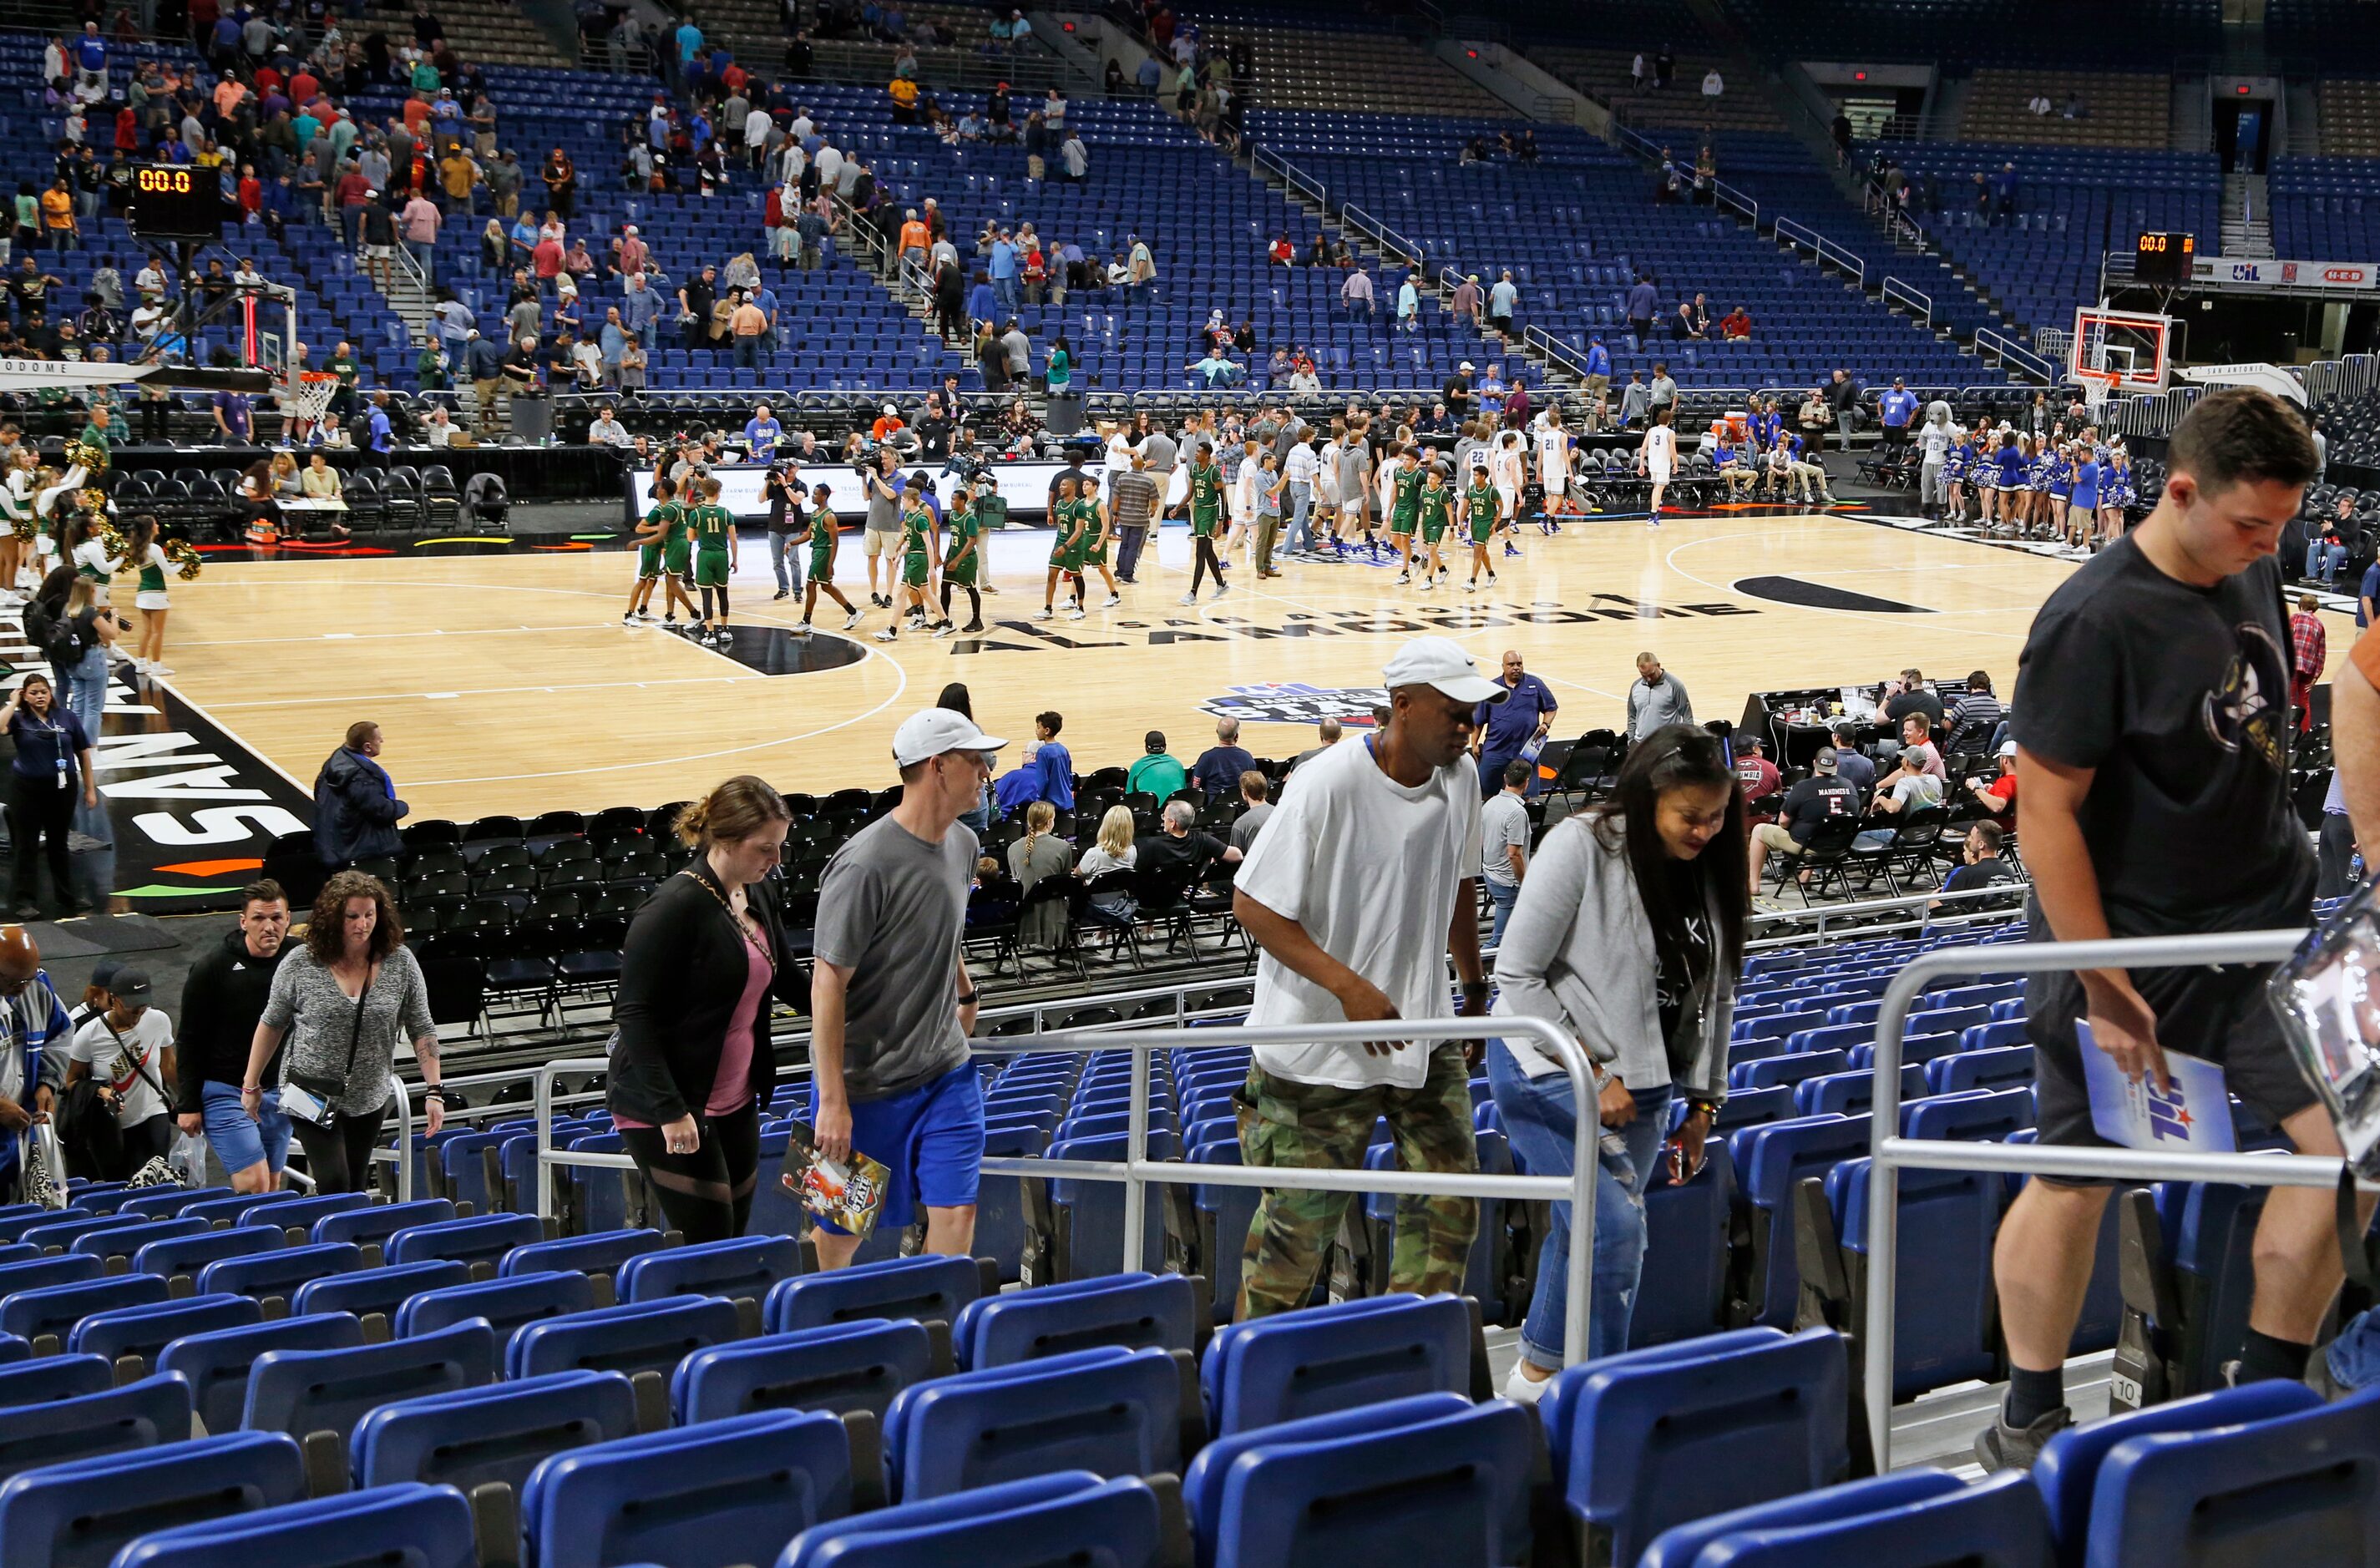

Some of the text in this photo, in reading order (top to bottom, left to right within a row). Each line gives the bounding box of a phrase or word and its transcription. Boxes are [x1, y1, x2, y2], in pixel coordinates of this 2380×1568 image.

[139, 169, 190, 192] 00.0
[2140, 235, 2165, 251] 00.0
[1546, 439, 1553, 450] 21
[1655, 435, 1660, 445] 3
[1472, 451, 1483, 463] 22
[1384, 469, 1389, 479] 4
[1398, 478, 1409, 488] COLE
[1196, 488, 1204, 498] 15
[1400, 488, 1405, 497] 0
[1423, 497, 1435, 506] COLE
[1426, 506, 1431, 515] 3
[1474, 505, 1483, 515] 12
[706, 517, 720, 533] 11
[950, 535, 959, 546] 13
[852, 1176, 868, 1212] STATE
[2119, 1380, 2134, 1400] 10
